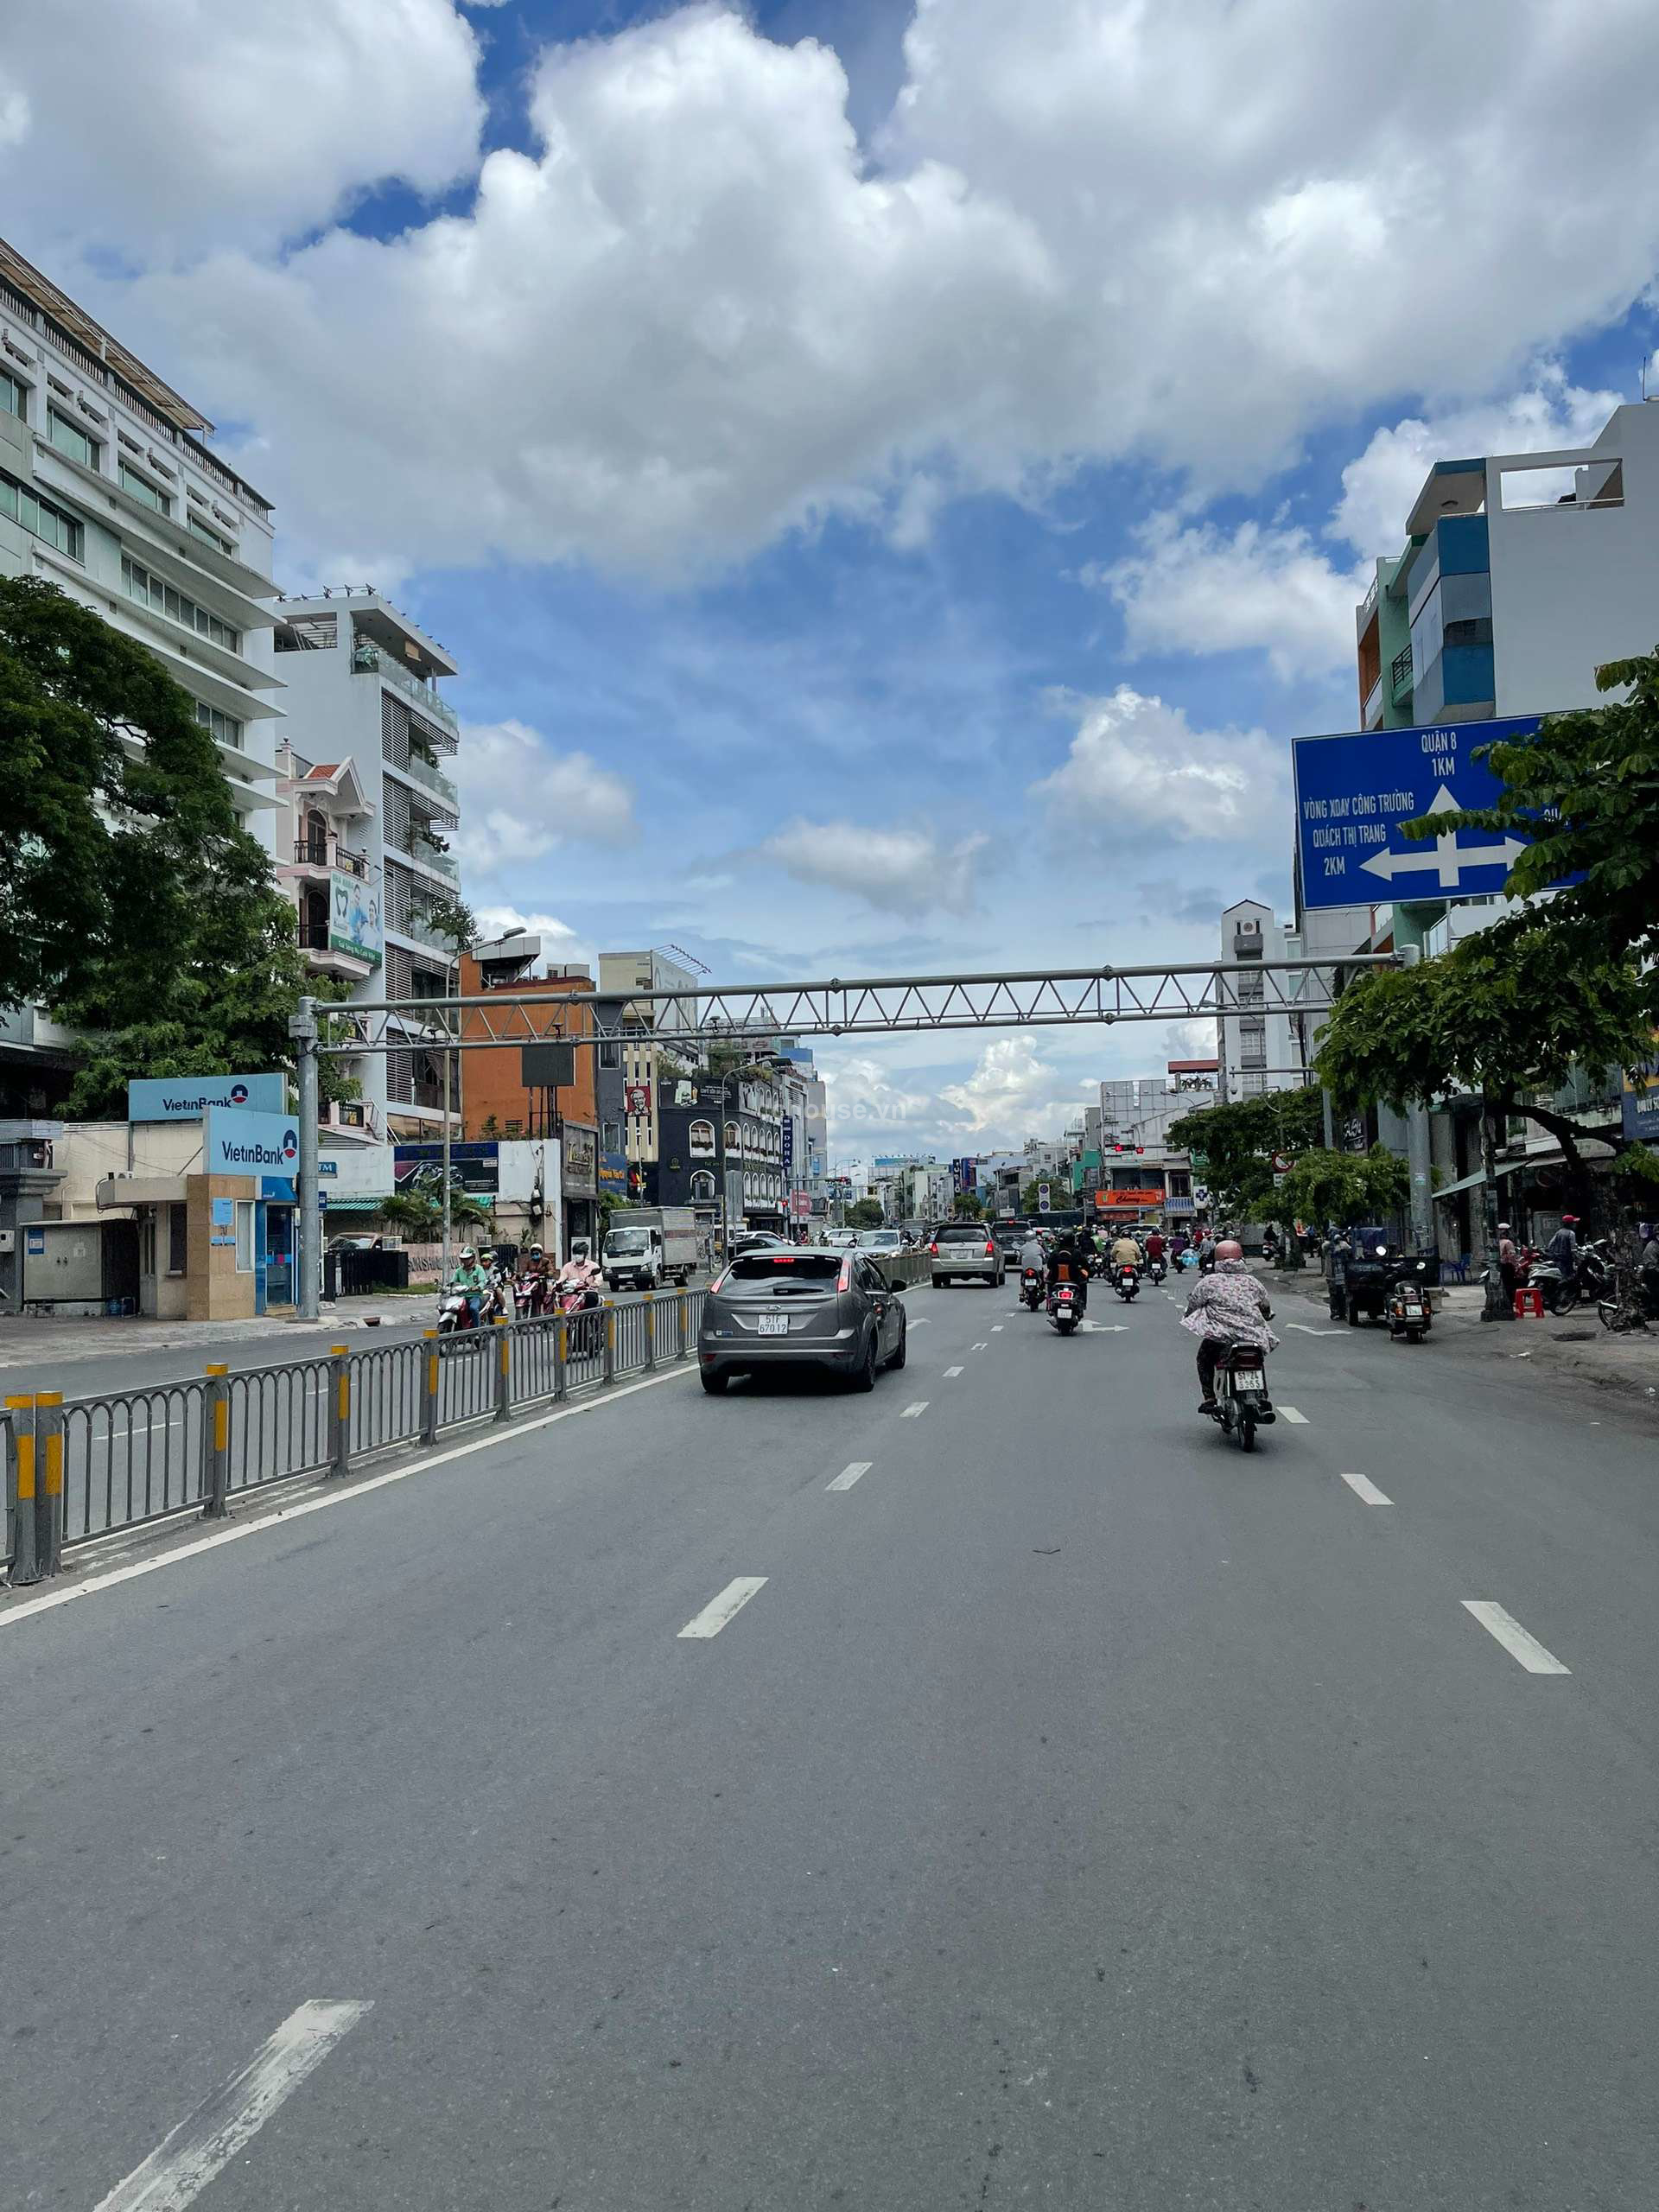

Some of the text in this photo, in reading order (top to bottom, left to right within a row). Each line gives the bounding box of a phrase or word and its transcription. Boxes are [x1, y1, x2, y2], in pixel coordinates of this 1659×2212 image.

[1421, 730, 1457, 755] QUẬN 8
[1432, 756, 1455, 777] 1KM
[1304, 788, 1414, 819] VÒNG XOAY CÔNG TRƯỜNG
[1313, 823, 1386, 848] QUÁCH THỊ TRANG
[1324, 856, 1345, 876] 2KM
[162, 1096, 232, 1112] VietinBank
[222, 1141, 283, 1165] VietinBank
[318, 1163, 333, 1172] TM
